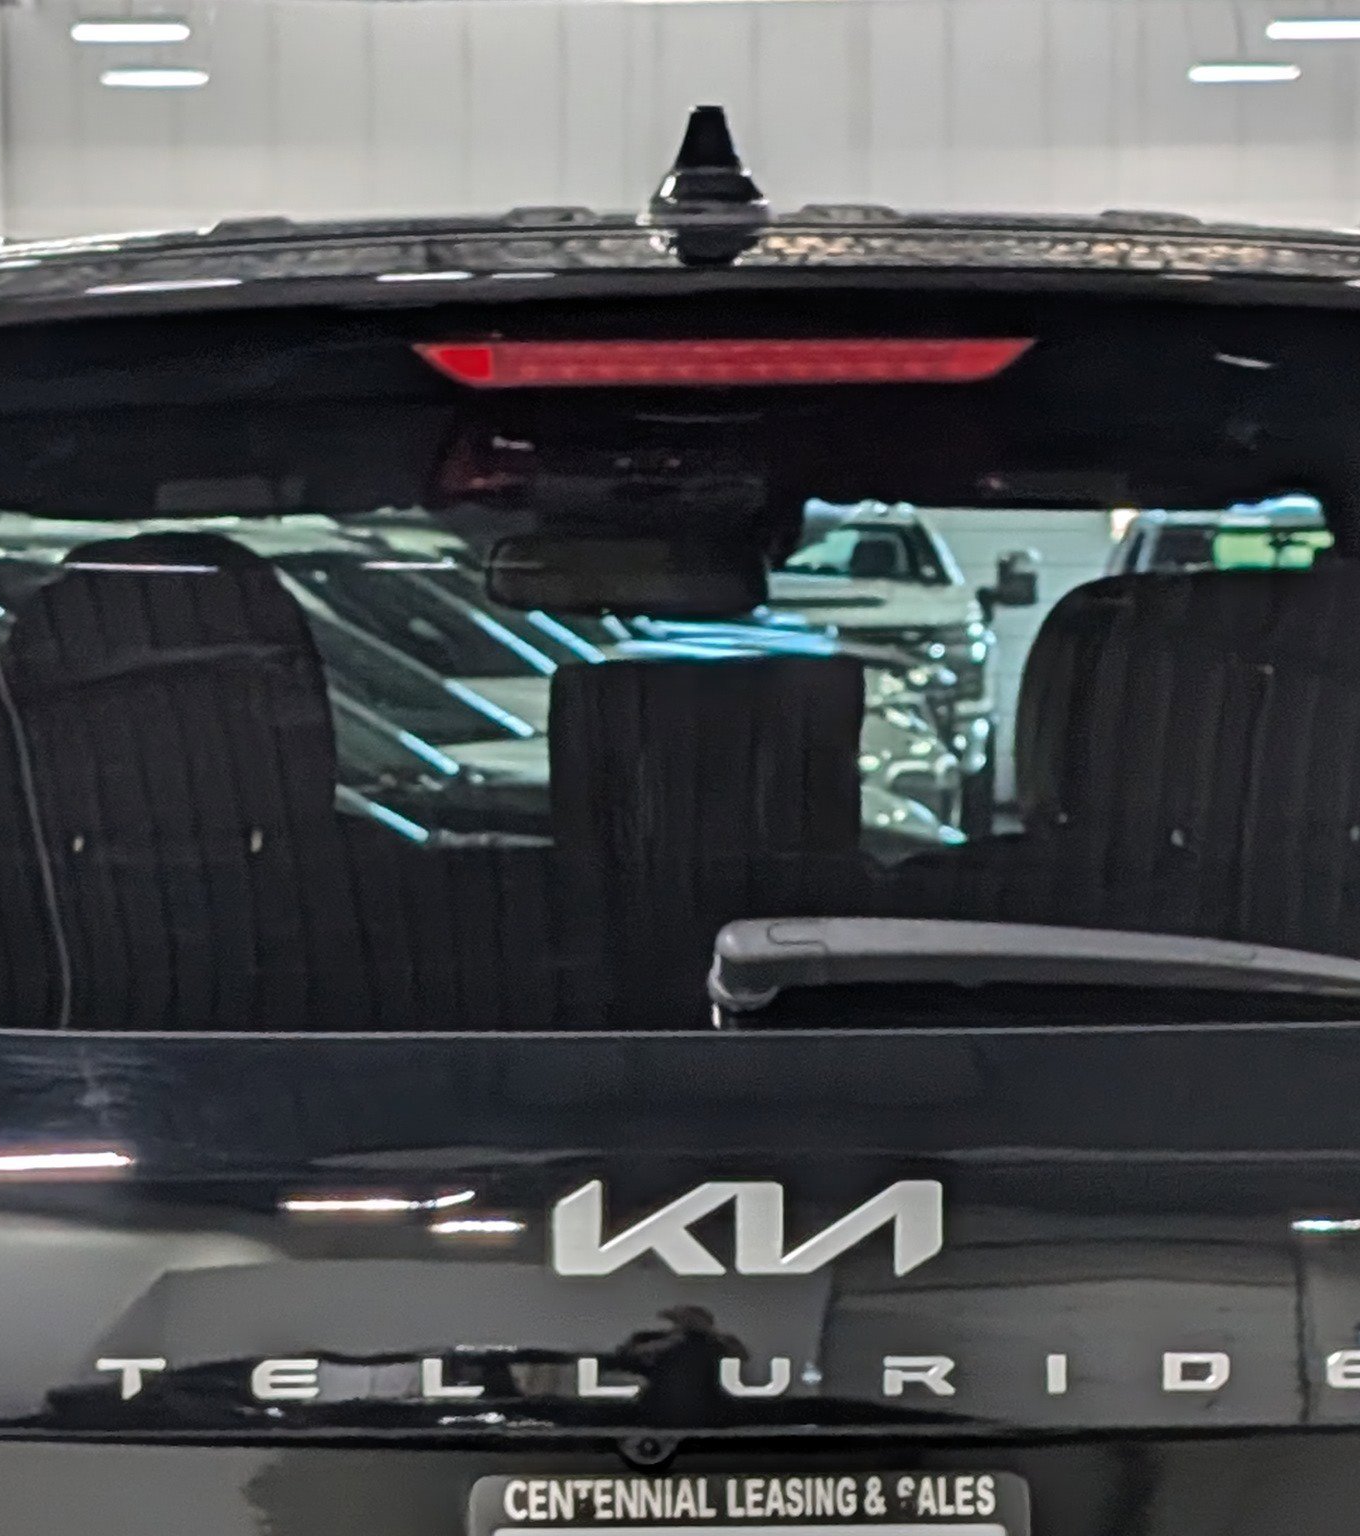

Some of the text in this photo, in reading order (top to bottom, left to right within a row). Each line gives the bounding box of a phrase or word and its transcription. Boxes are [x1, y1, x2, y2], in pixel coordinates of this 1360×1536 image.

[553, 1179, 943, 1277] KIA
[726, 1477, 857, 1518] LEASING
[863, 1476, 887, 1515] &
